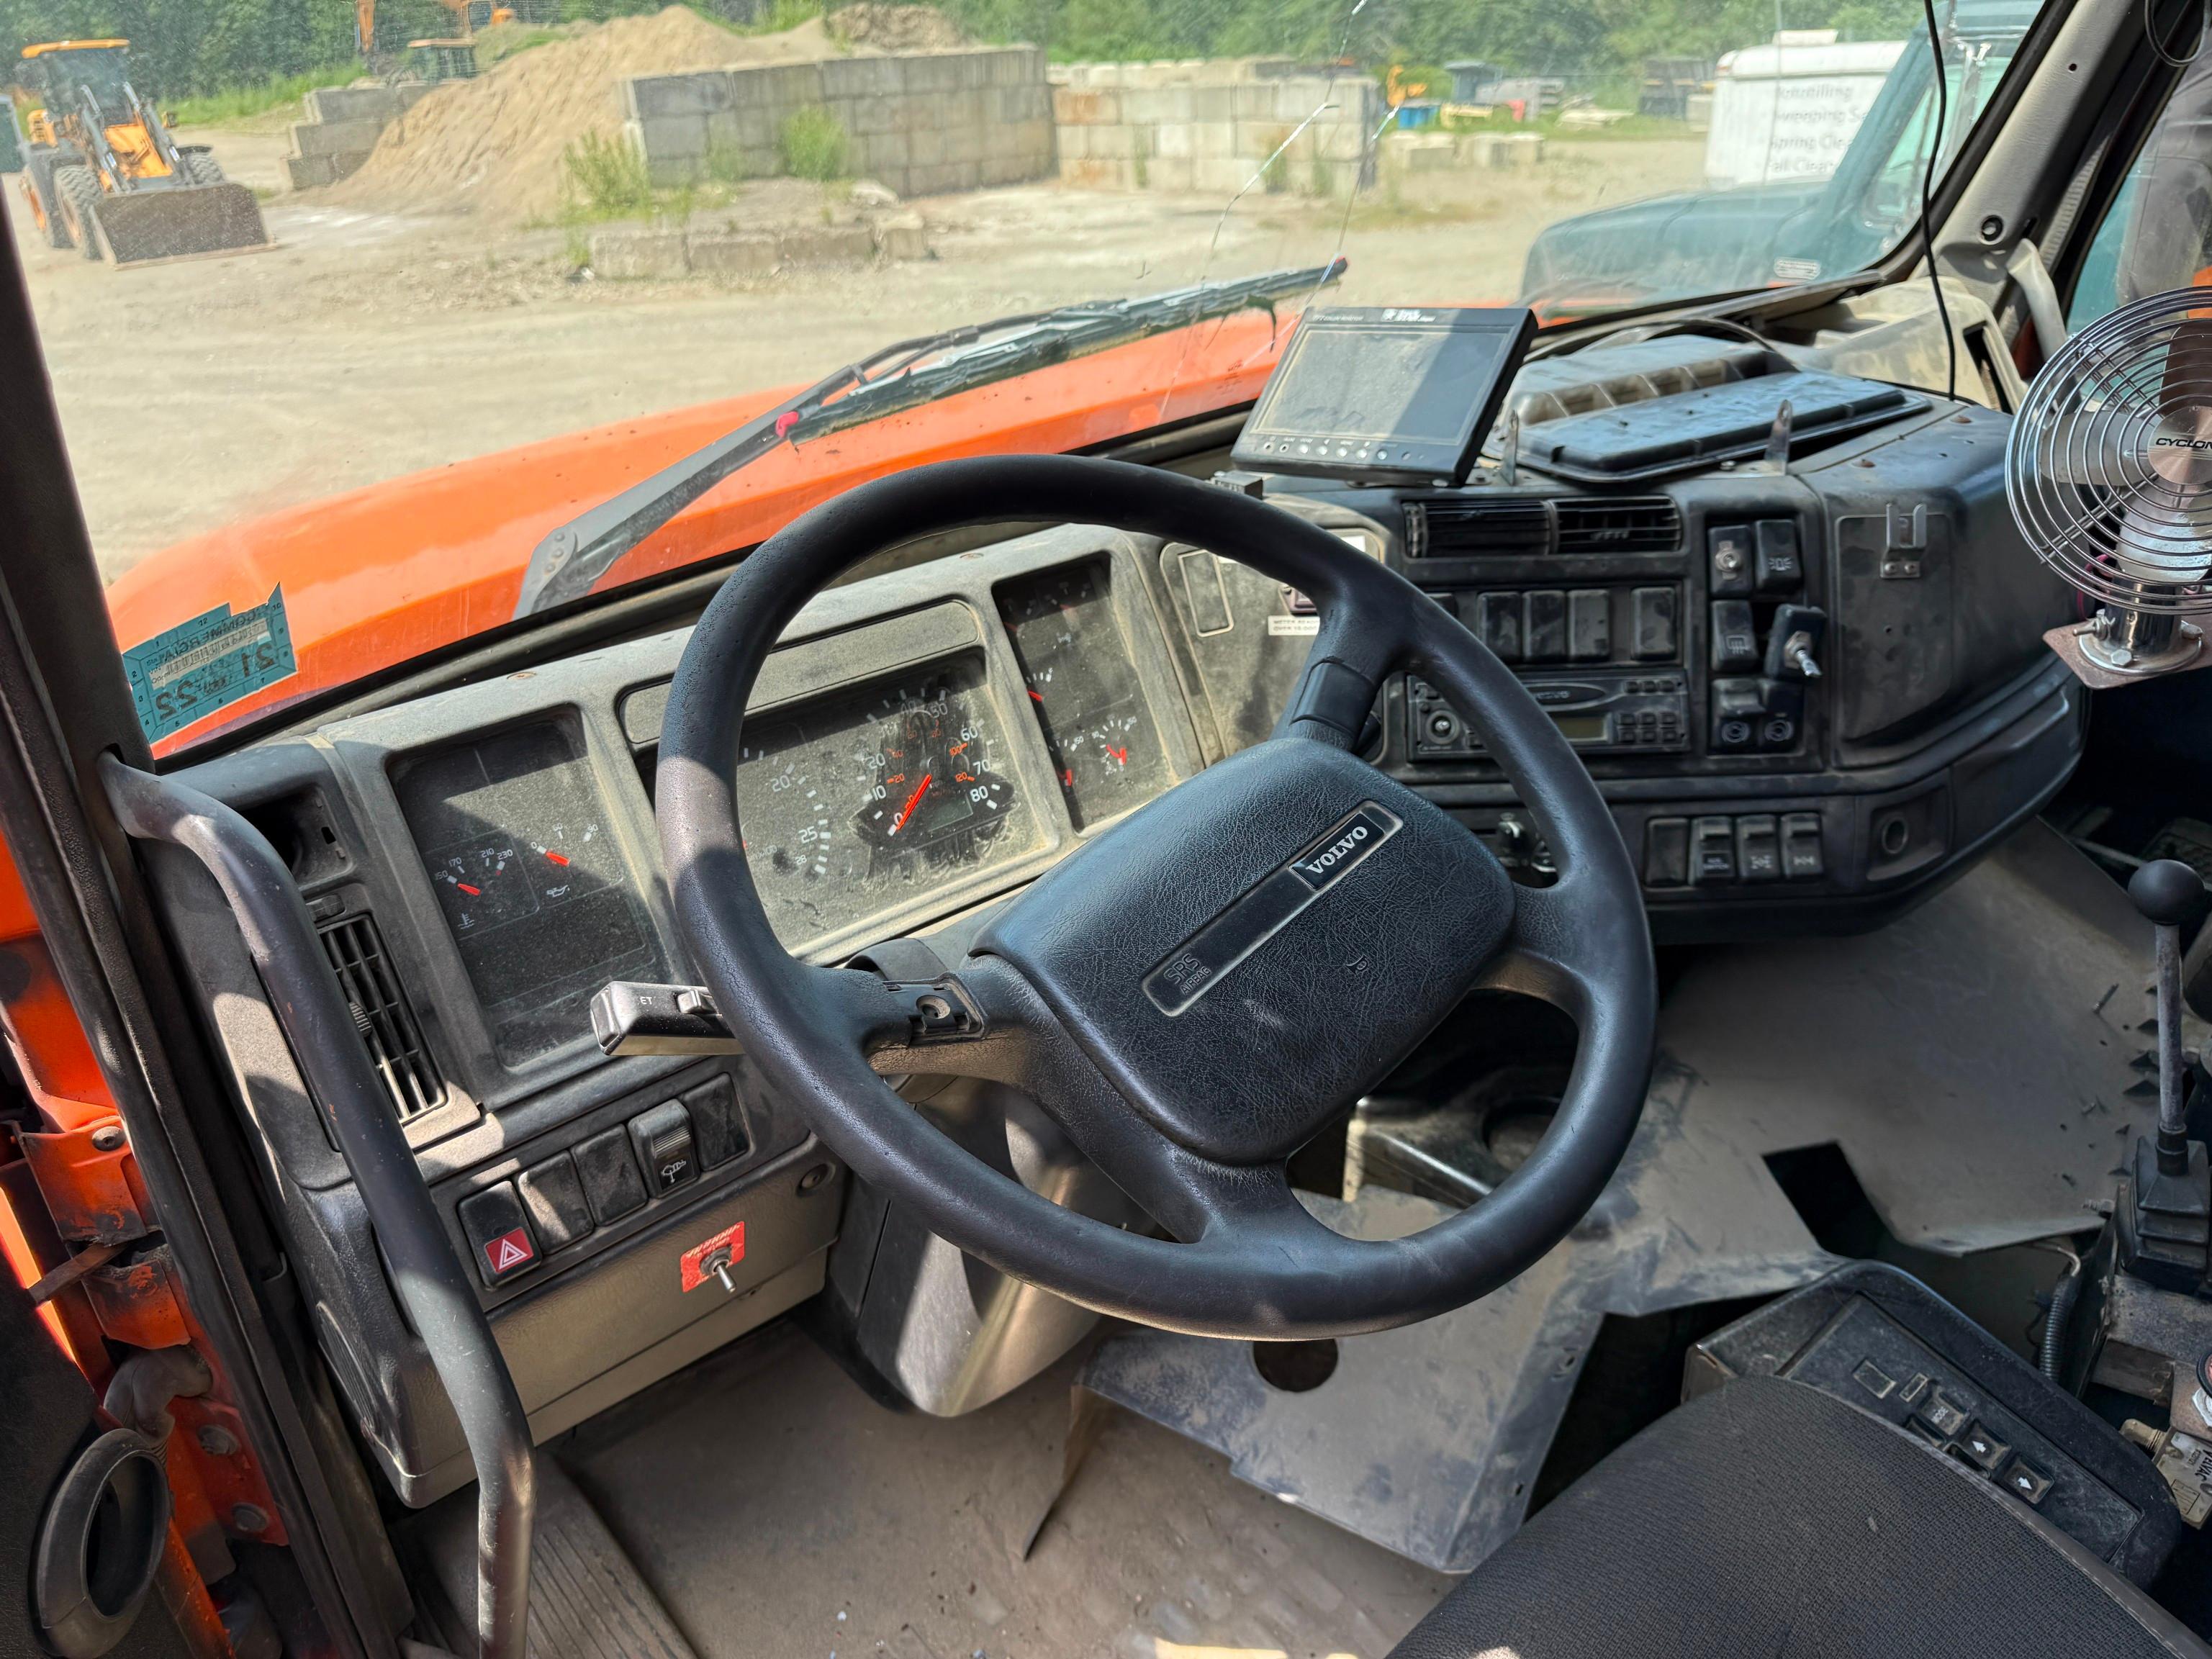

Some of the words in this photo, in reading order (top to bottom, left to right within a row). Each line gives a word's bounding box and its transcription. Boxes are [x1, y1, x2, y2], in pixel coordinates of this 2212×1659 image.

[199, 618, 207, 626] 12
[931, 703, 948, 719] 50
[961, 725, 978, 741] 60
[949, 747, 962, 756] 100
[865, 753, 886, 769] 20
[972, 759, 990, 775] 70
[770, 774, 791, 792] 20
[893, 773, 905, 784] 20
[955, 772, 967, 782] 120
[872, 785, 887, 801] 10
[970, 785, 988, 803] 80
[893, 812, 903, 825] 0
[798, 826, 818, 844] 25
[480, 848, 495, 859] 210
[497, 849, 513, 860] 230
[1304, 825, 1369, 875] VOLVO
[448, 856, 462, 867] 170
[795, 854, 807, 865] 28
[1163, 953, 1201, 985] SRS
[1180, 965, 1211, 995] AIRBAG
